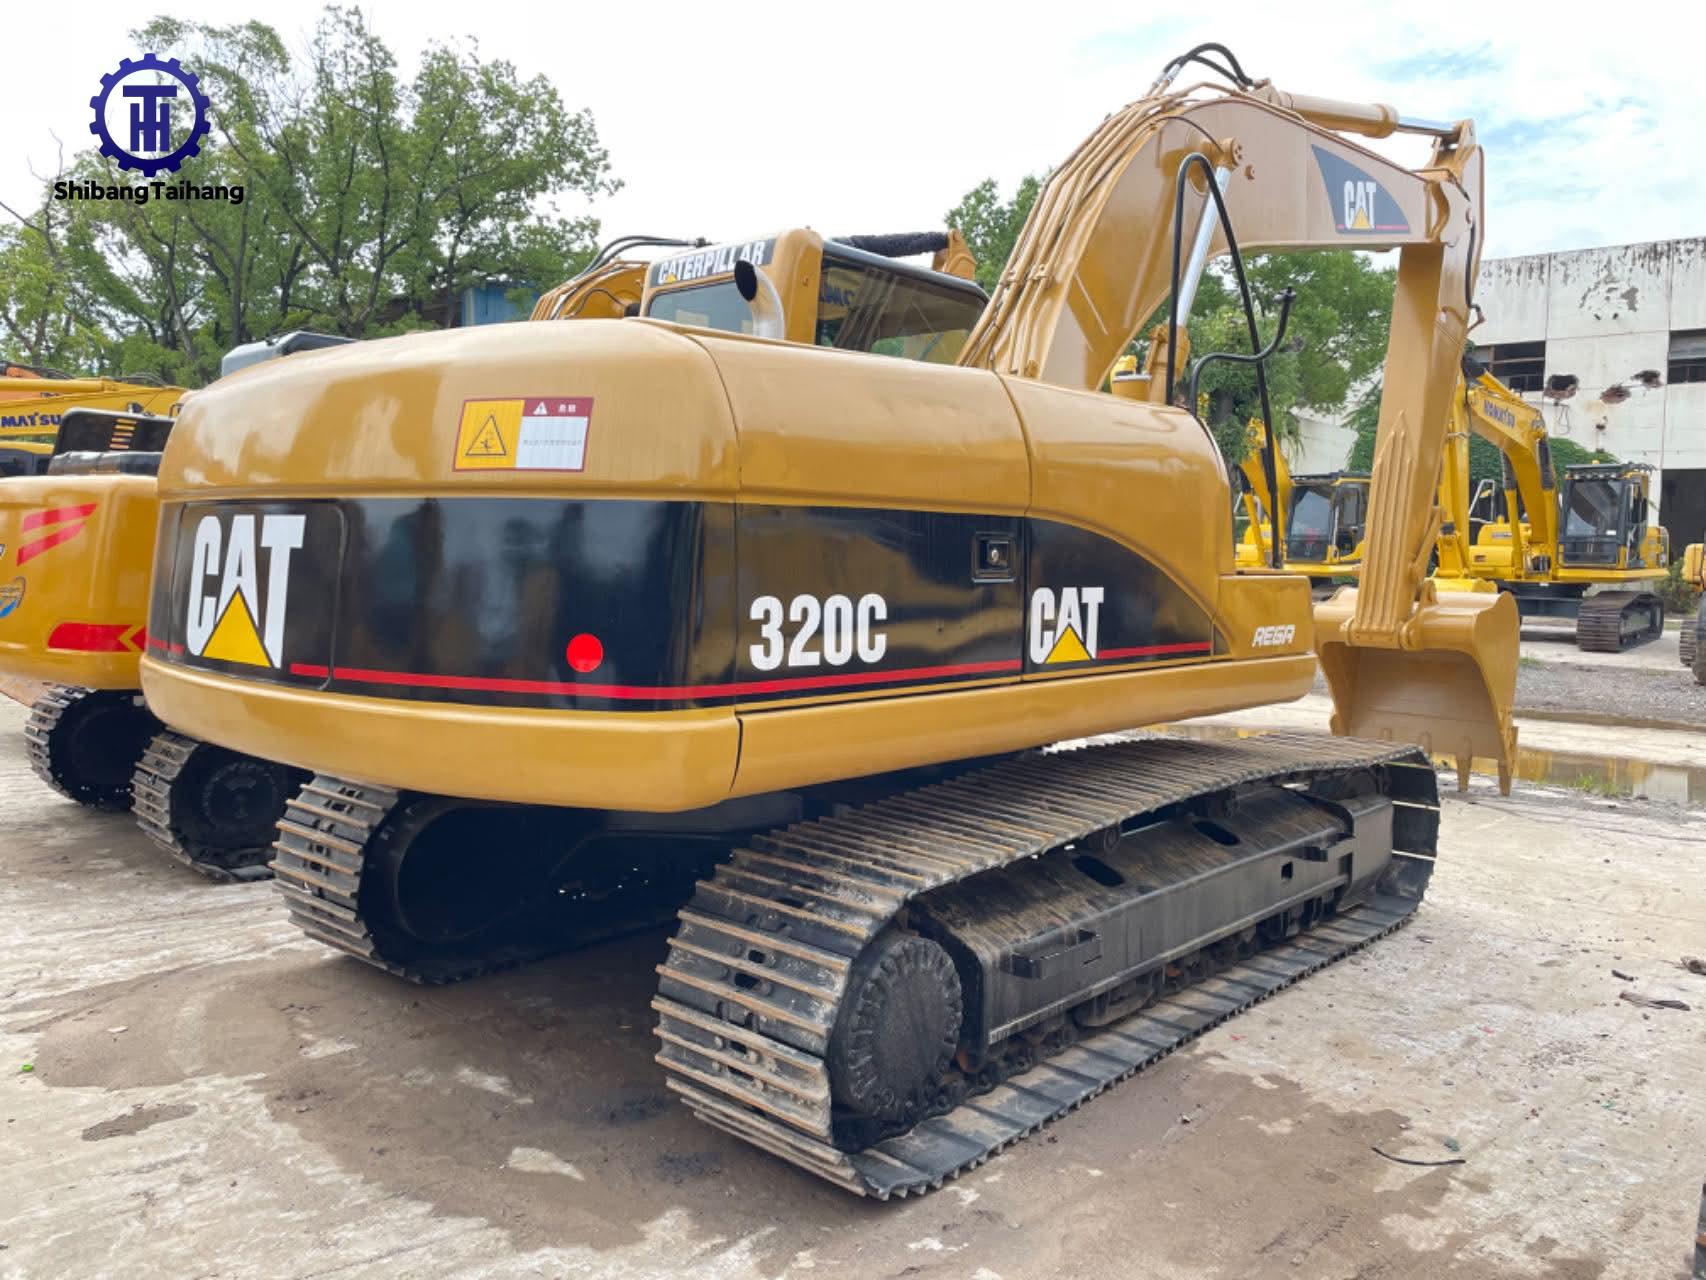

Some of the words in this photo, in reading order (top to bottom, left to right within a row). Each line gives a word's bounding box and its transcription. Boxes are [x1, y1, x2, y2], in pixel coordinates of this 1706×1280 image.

[1344, 181, 1376, 229] CAT
[657, 241, 765, 284] CATERPILLAR
[187, 514, 306, 669] CAT
[1030, 587, 1104, 664] CAT
[750, 593, 887, 671] 320C
